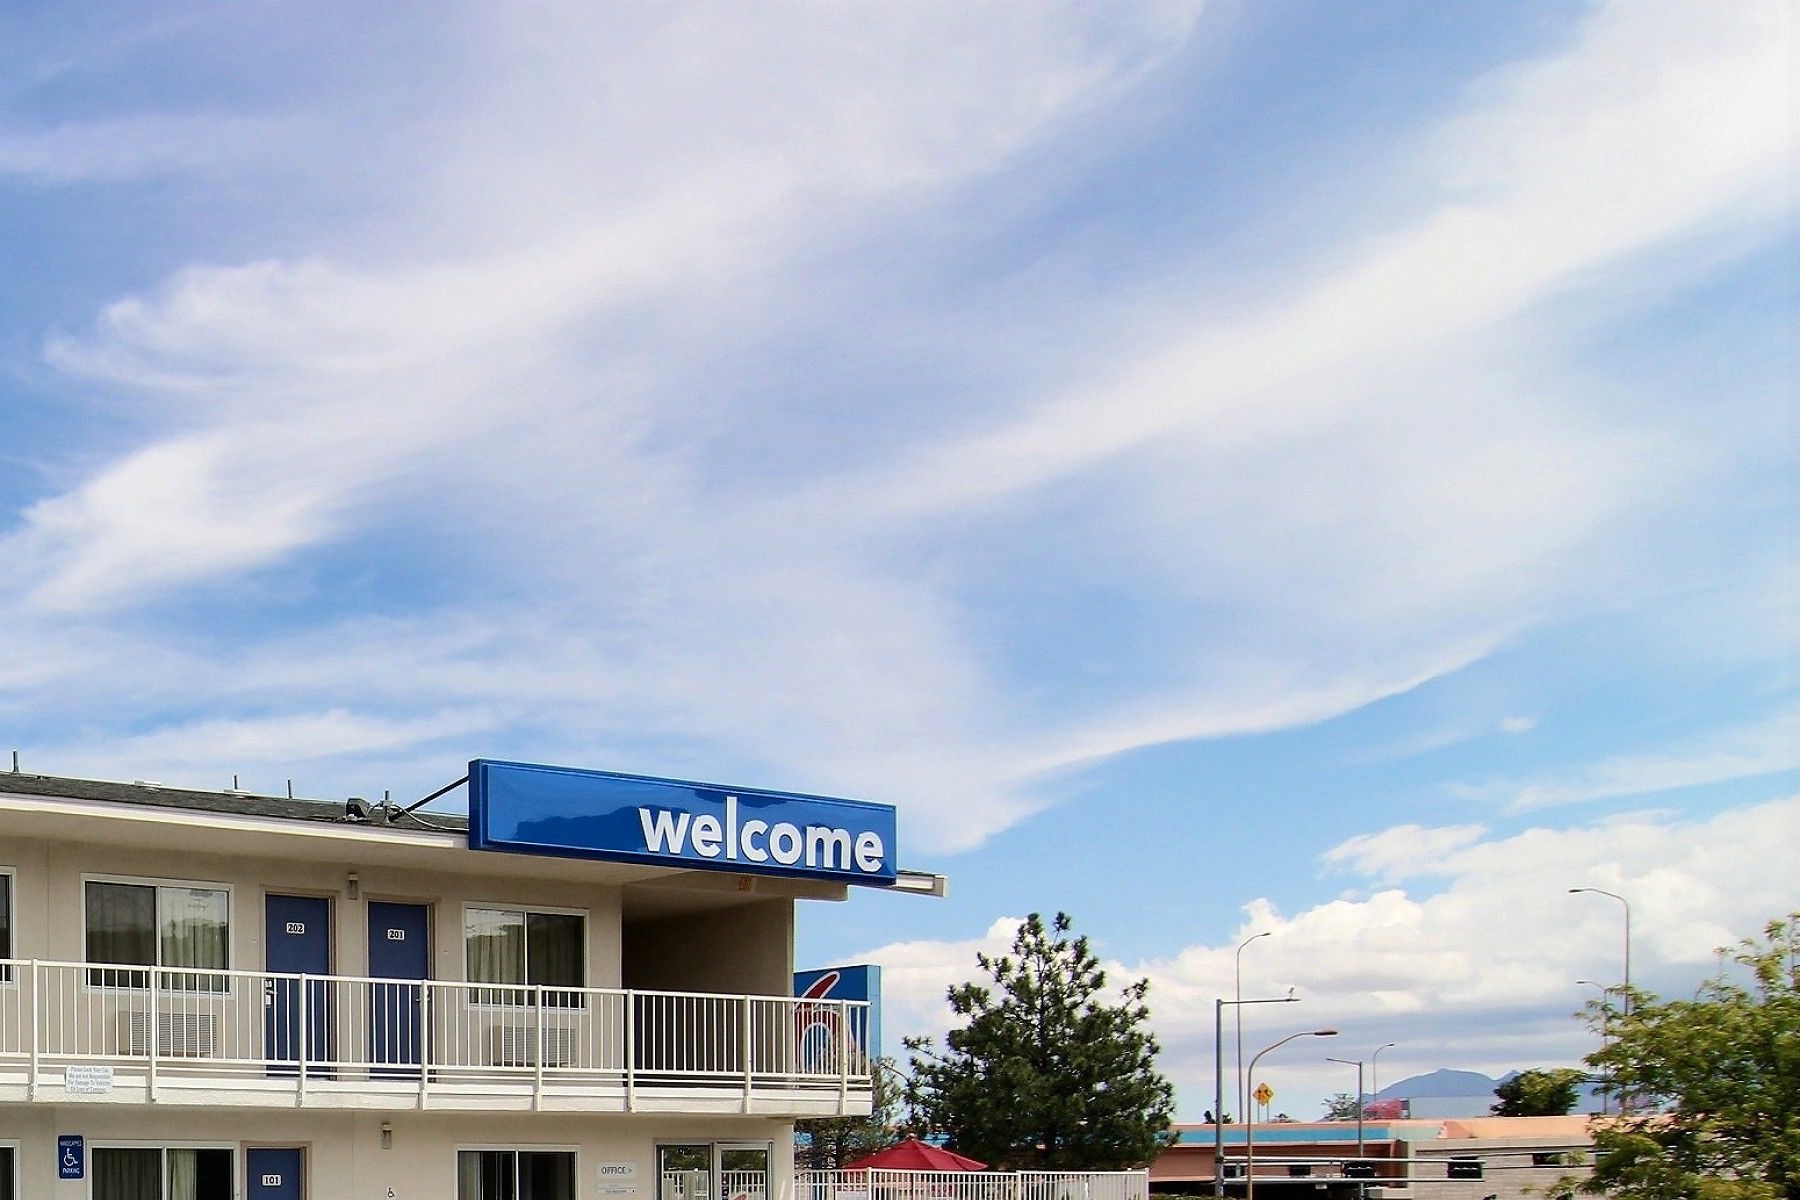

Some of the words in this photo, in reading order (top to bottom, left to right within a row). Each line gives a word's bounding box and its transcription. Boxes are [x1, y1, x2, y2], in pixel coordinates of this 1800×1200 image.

[639, 796, 884, 873] welcome
[288, 924, 303, 933] 202
[389, 930, 403, 939] 201
[601, 1166, 626, 1175] OFFICE
[264, 1176, 279, 1184] 101
